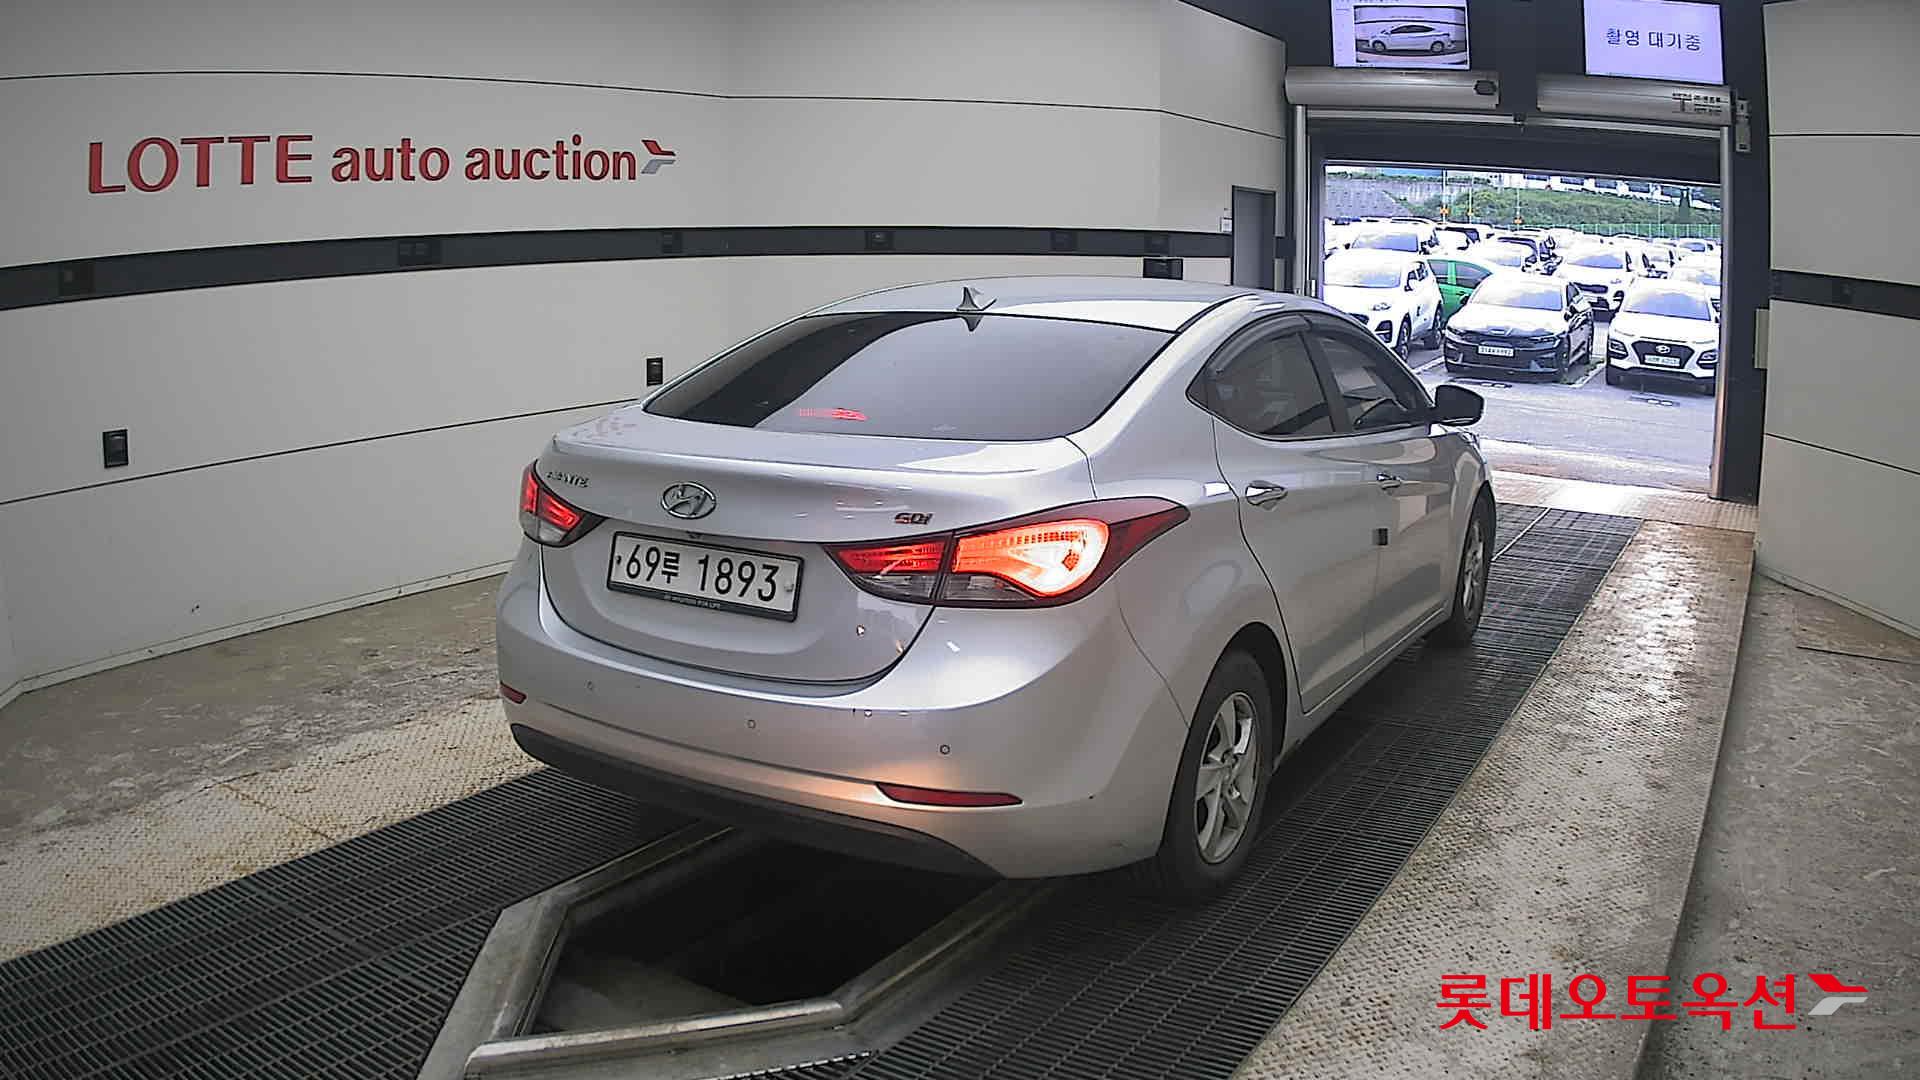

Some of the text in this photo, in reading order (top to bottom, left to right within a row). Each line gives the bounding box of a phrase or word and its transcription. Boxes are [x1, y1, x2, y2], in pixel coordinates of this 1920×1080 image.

[1606, 28, 1701, 52] 촬영 대기중
[88, 134, 637, 194] LOTTE auto auction
[626, 544, 780, 602] 69루 1893
